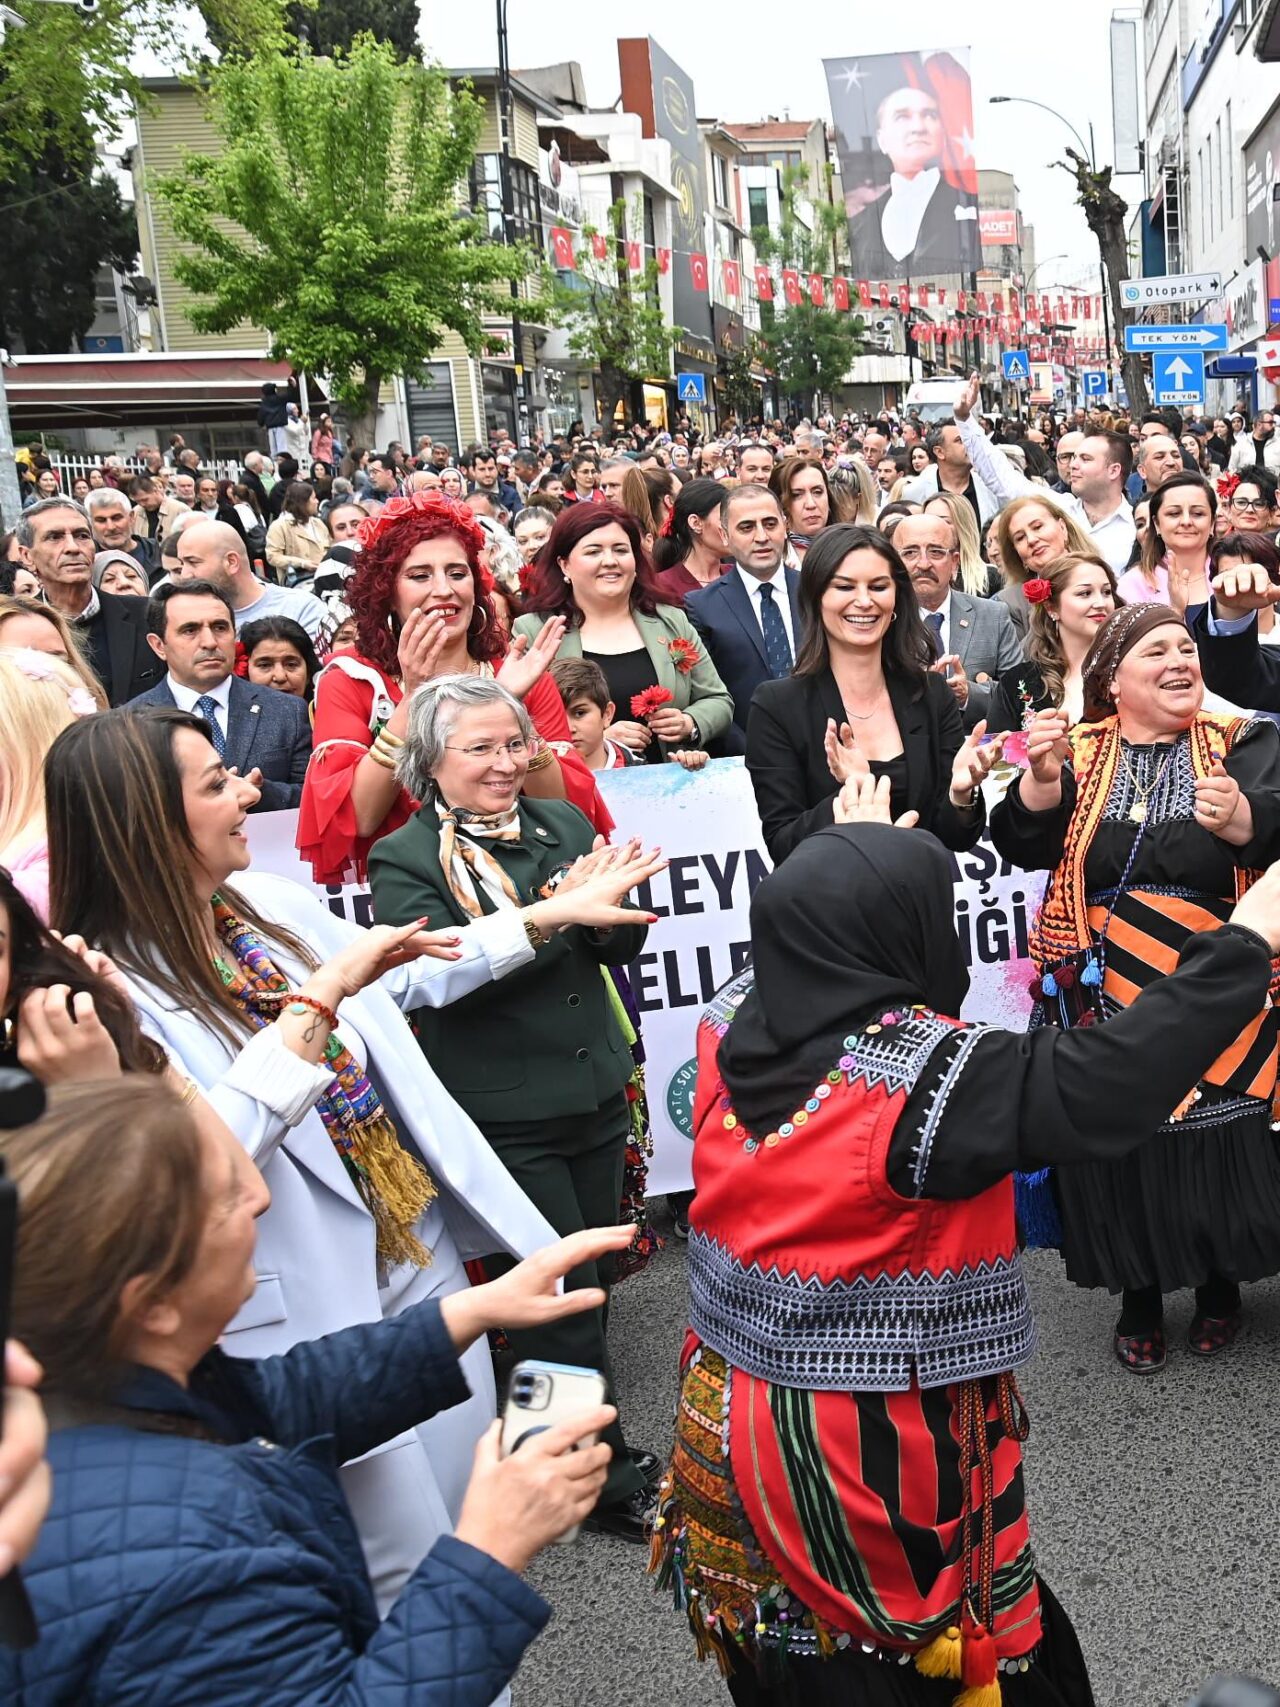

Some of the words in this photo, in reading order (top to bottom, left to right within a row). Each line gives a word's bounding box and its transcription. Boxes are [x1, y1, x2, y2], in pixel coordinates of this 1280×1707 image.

[1145, 283, 1203, 297] Otopark
[1141, 335, 1163, 343] TEK
[1172, 333, 1198, 342] YÖN
[1088, 374, 1102, 394] P
